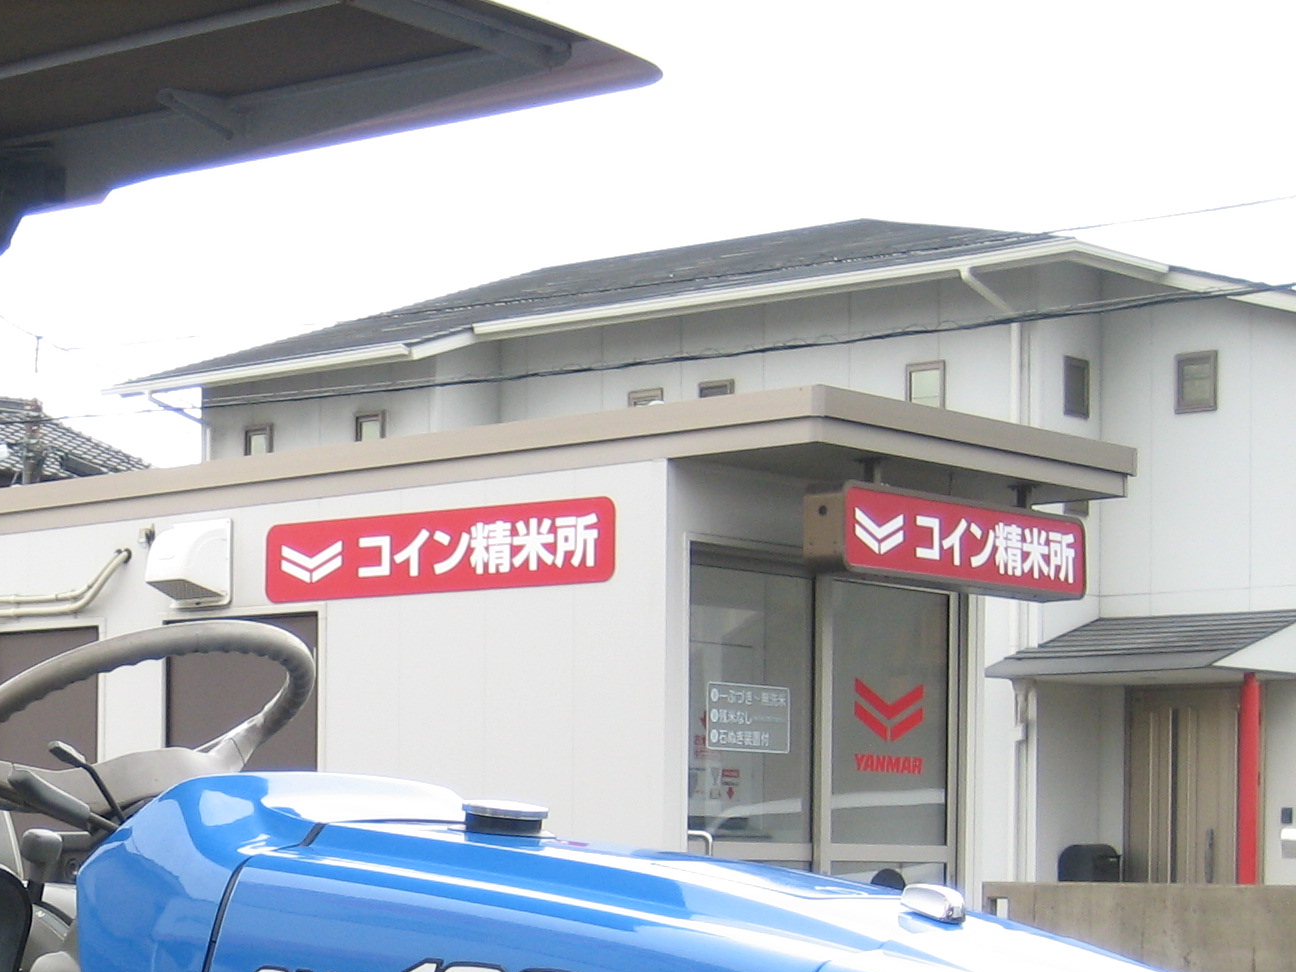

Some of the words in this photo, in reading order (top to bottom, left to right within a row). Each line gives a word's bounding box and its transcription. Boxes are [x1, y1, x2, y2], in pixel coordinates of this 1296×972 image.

[357, 512, 599, 578] コイン精米所
[915, 515, 1076, 584] コイン精米所
[854, 753, 923, 774] YANMAR
